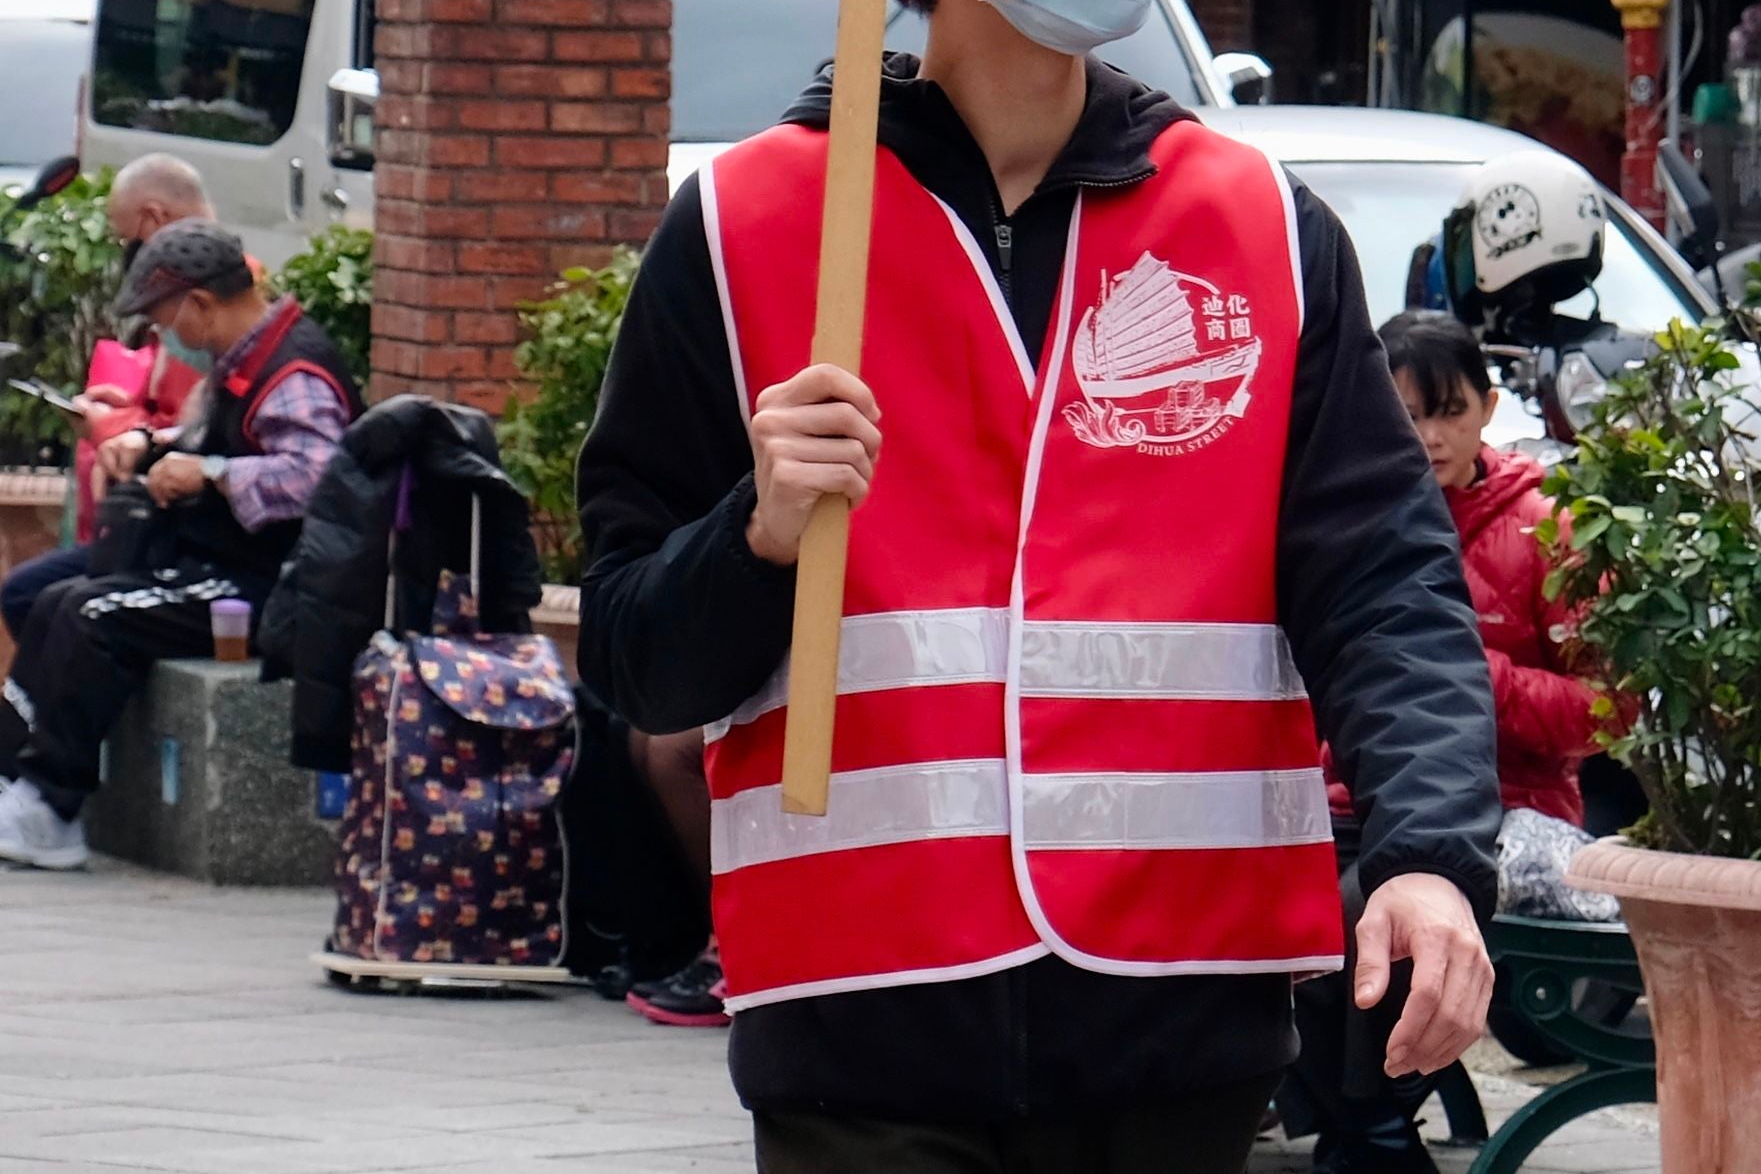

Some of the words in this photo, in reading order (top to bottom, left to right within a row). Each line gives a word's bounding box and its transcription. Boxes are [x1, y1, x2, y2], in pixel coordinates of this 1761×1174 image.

[1202, 294, 1250, 317] 迪化
[1137, 442, 1186, 458] DIHUA
[1187, 416, 1236, 454] STREET
